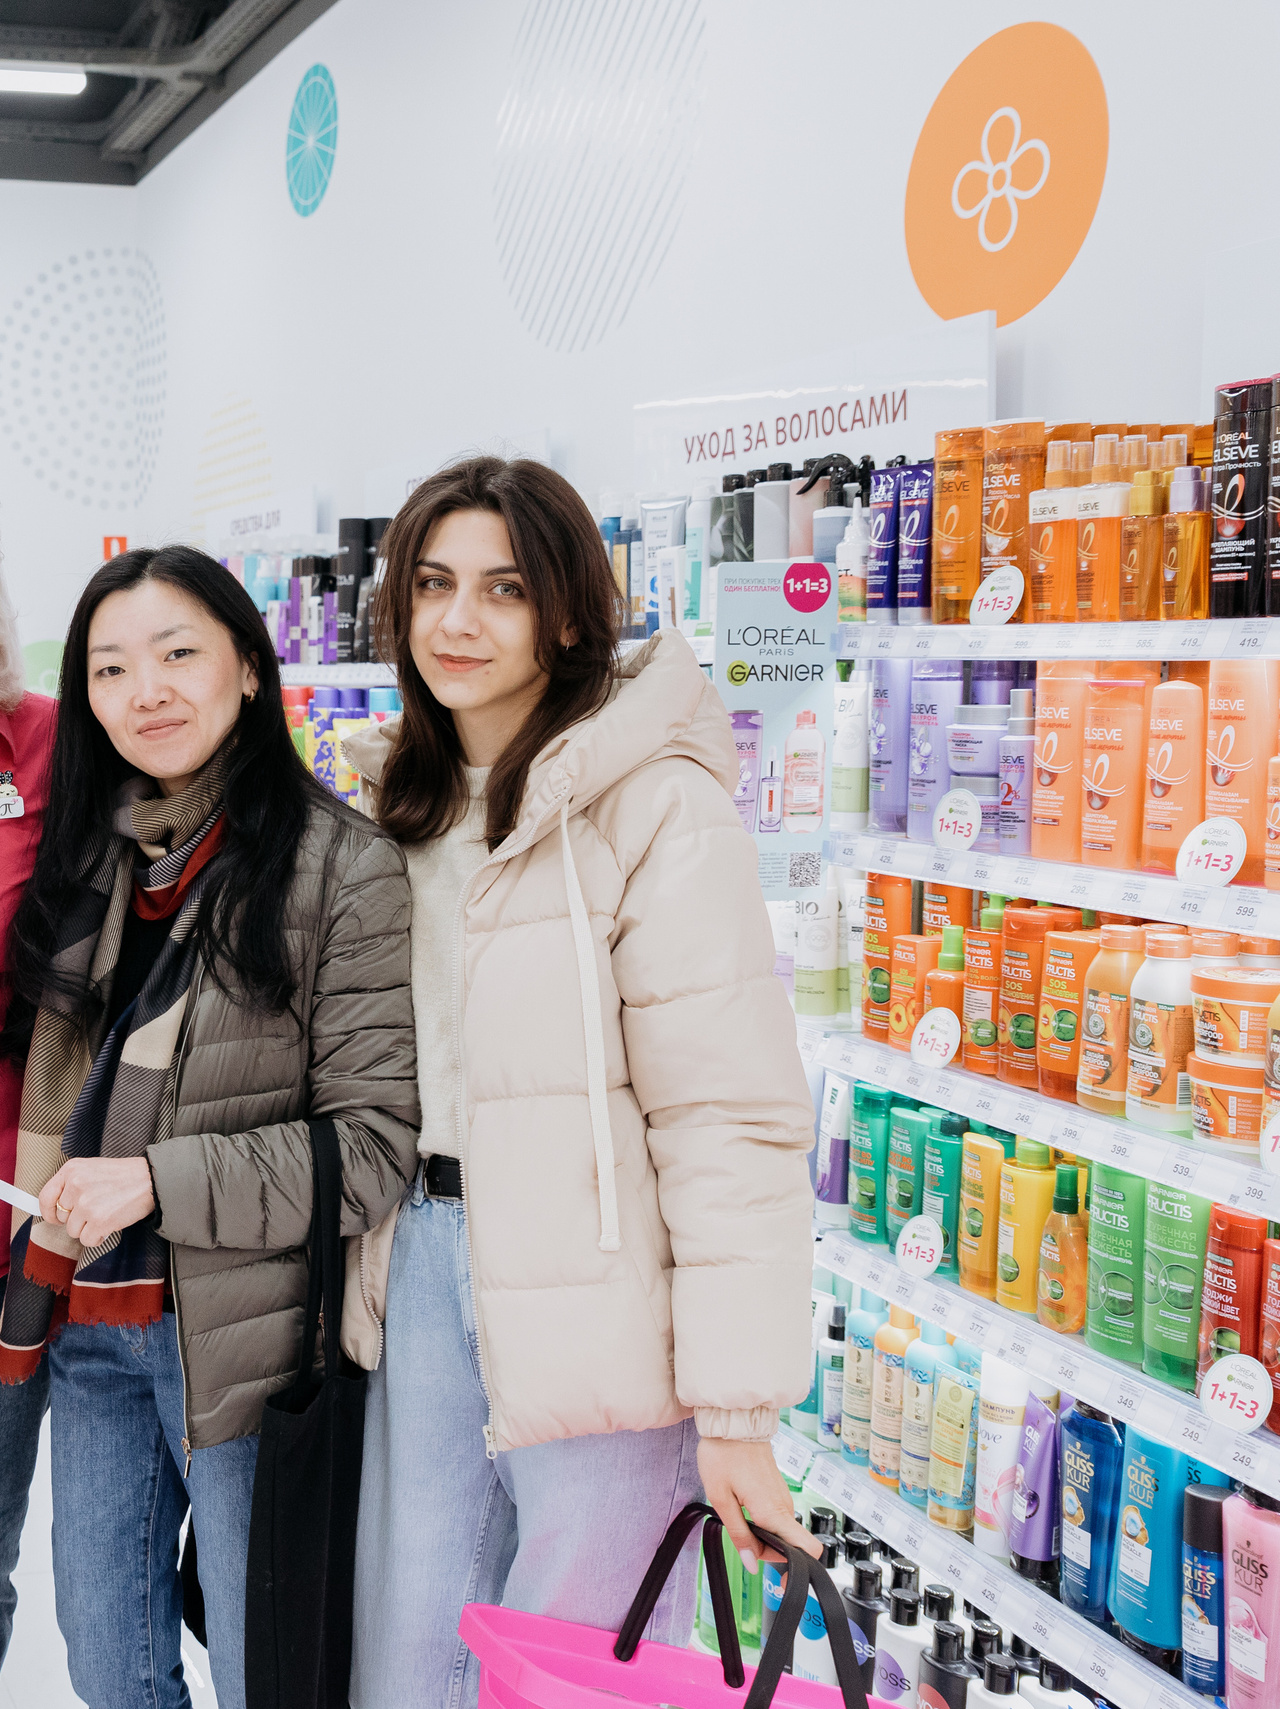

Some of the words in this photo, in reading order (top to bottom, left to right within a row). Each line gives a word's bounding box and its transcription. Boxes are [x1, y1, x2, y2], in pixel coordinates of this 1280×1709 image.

[684, 427, 736, 464] УХОД
[742, 423, 769, 453] ЗА
[775, 388, 908, 446] ВОЛОСАМИ
[1213, 444, 1259, 463] ELSEVE
[983, 473, 1021, 489] ELSEVE
[724, 585, 743, 593] ОДИН
[743, 585, 782, 593] БЕСПЛАТНО!
[786, 578, 829, 593] 1+1=3
[977, 595, 1014, 613] 1+1=3
[727, 626, 825, 647] L'ORÉAL
[1181, 638, 1198, 647] 419
[1239, 638, 1258, 647] 419
[759, 648, 794, 656] PARIS
[730, 664, 824, 682] GARNIER
[1209, 698, 1245, 711] ELSEVE
[1150, 719, 1183, 731] ELSEVE
[1084, 728, 1122, 741] ELSEVE
[938, 817, 973, 839] 1+1=3
[842, 848, 854, 856] 429
[879, 855, 892, 864] 429
[1185, 850, 1234, 872] 1+1=3
[932, 862, 945, 872] 599
[974, 869, 988, 879] 559
[1122, 892, 1138, 902] 299
[1180, 902, 1198, 913] 419
[1235, 905, 1255, 917] 599
[1001, 964, 1032, 979] FRUCTIS
[1045, 963, 1076, 978] FRUCTIS
[1005, 980, 1023, 991] SOS
[1049, 978, 1067, 990] SOS
[1086, 1001, 1111, 1014] FRUCTIS
[1132, 1010, 1159, 1024] FRUCTIS
[918, 1031, 950, 1058] 1+1=3
[936, 1085, 949, 1096] 377
[976, 1100, 991, 1111] 249
[1015, 1112, 1030, 1123] 249
[1062, 1128, 1078, 1139] 399
[1110, 1144, 1127, 1156] 399
[1172, 1163, 1190, 1177] 539
[1149, 1184, 1187, 1202] GARNIER
[1245, 1186, 1264, 1200] 399
[1147, 1195, 1193, 1219] FRUCTIS
[1089, 1204, 1130, 1229] FRUCTIS
[902, 1242, 935, 1264] 1+1=3
[867, 1271, 880, 1282] 249
[1203, 1268, 1237, 1290] FRUCTIS
[895, 1285, 909, 1297] 377
[1203, 1286, 1233, 1304] ГОДЖИ
[931, 1303, 946, 1315] 249
[1220, 1303, 1240, 1316] ЦВЕТ
[969, 1322, 984, 1334] 377
[1010, 1342, 1025, 1354] 599
[1058, 1366, 1074, 1379] 349
[1117, 1395, 1134, 1409] 349
[1210, 1382, 1260, 1419] 1+1=3
[1182, 1427, 1200, 1442] 249
[1064, 1449, 1095, 1478] GLISS
[1232, 1452, 1252, 1467] 249
[1065, 1466, 1091, 1489] KUR
[1127, 1465, 1160, 1493] GLISS
[841, 1488, 853, 1501] 369
[1128, 1481, 1155, 1504] KUR
[871, 1510, 883, 1524] 369
[947, 1563, 961, 1578] 549
[1231, 1549, 1269, 1579] GLISS
[1183, 1562, 1216, 1586] GLISS
[1234, 1564, 1264, 1593] KUR
[1183, 1578, 1212, 1596] KUR
[981, 1588, 996, 1602] 429
[1032, 1621, 1048, 1637] 399
[1089, 1661, 1107, 1678] 399
